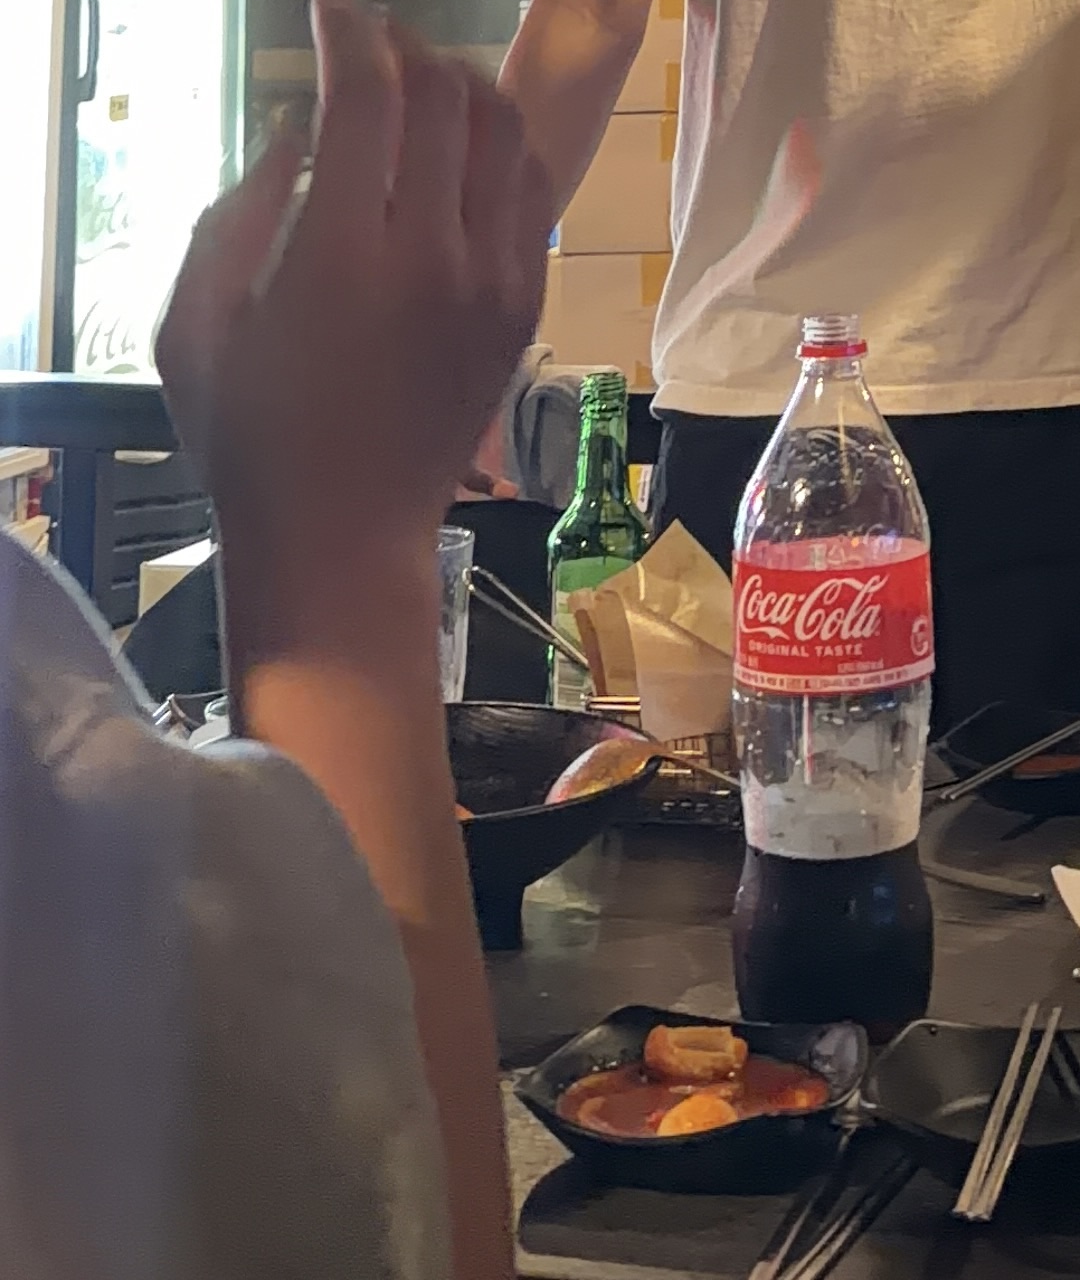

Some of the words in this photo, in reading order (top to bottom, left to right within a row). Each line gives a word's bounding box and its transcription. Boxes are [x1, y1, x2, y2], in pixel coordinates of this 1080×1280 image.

[739, 573, 889, 641] Coca-Cola
[748, 640, 810, 658] ORIGINAL
[815, 643, 864, 657] TASTE
